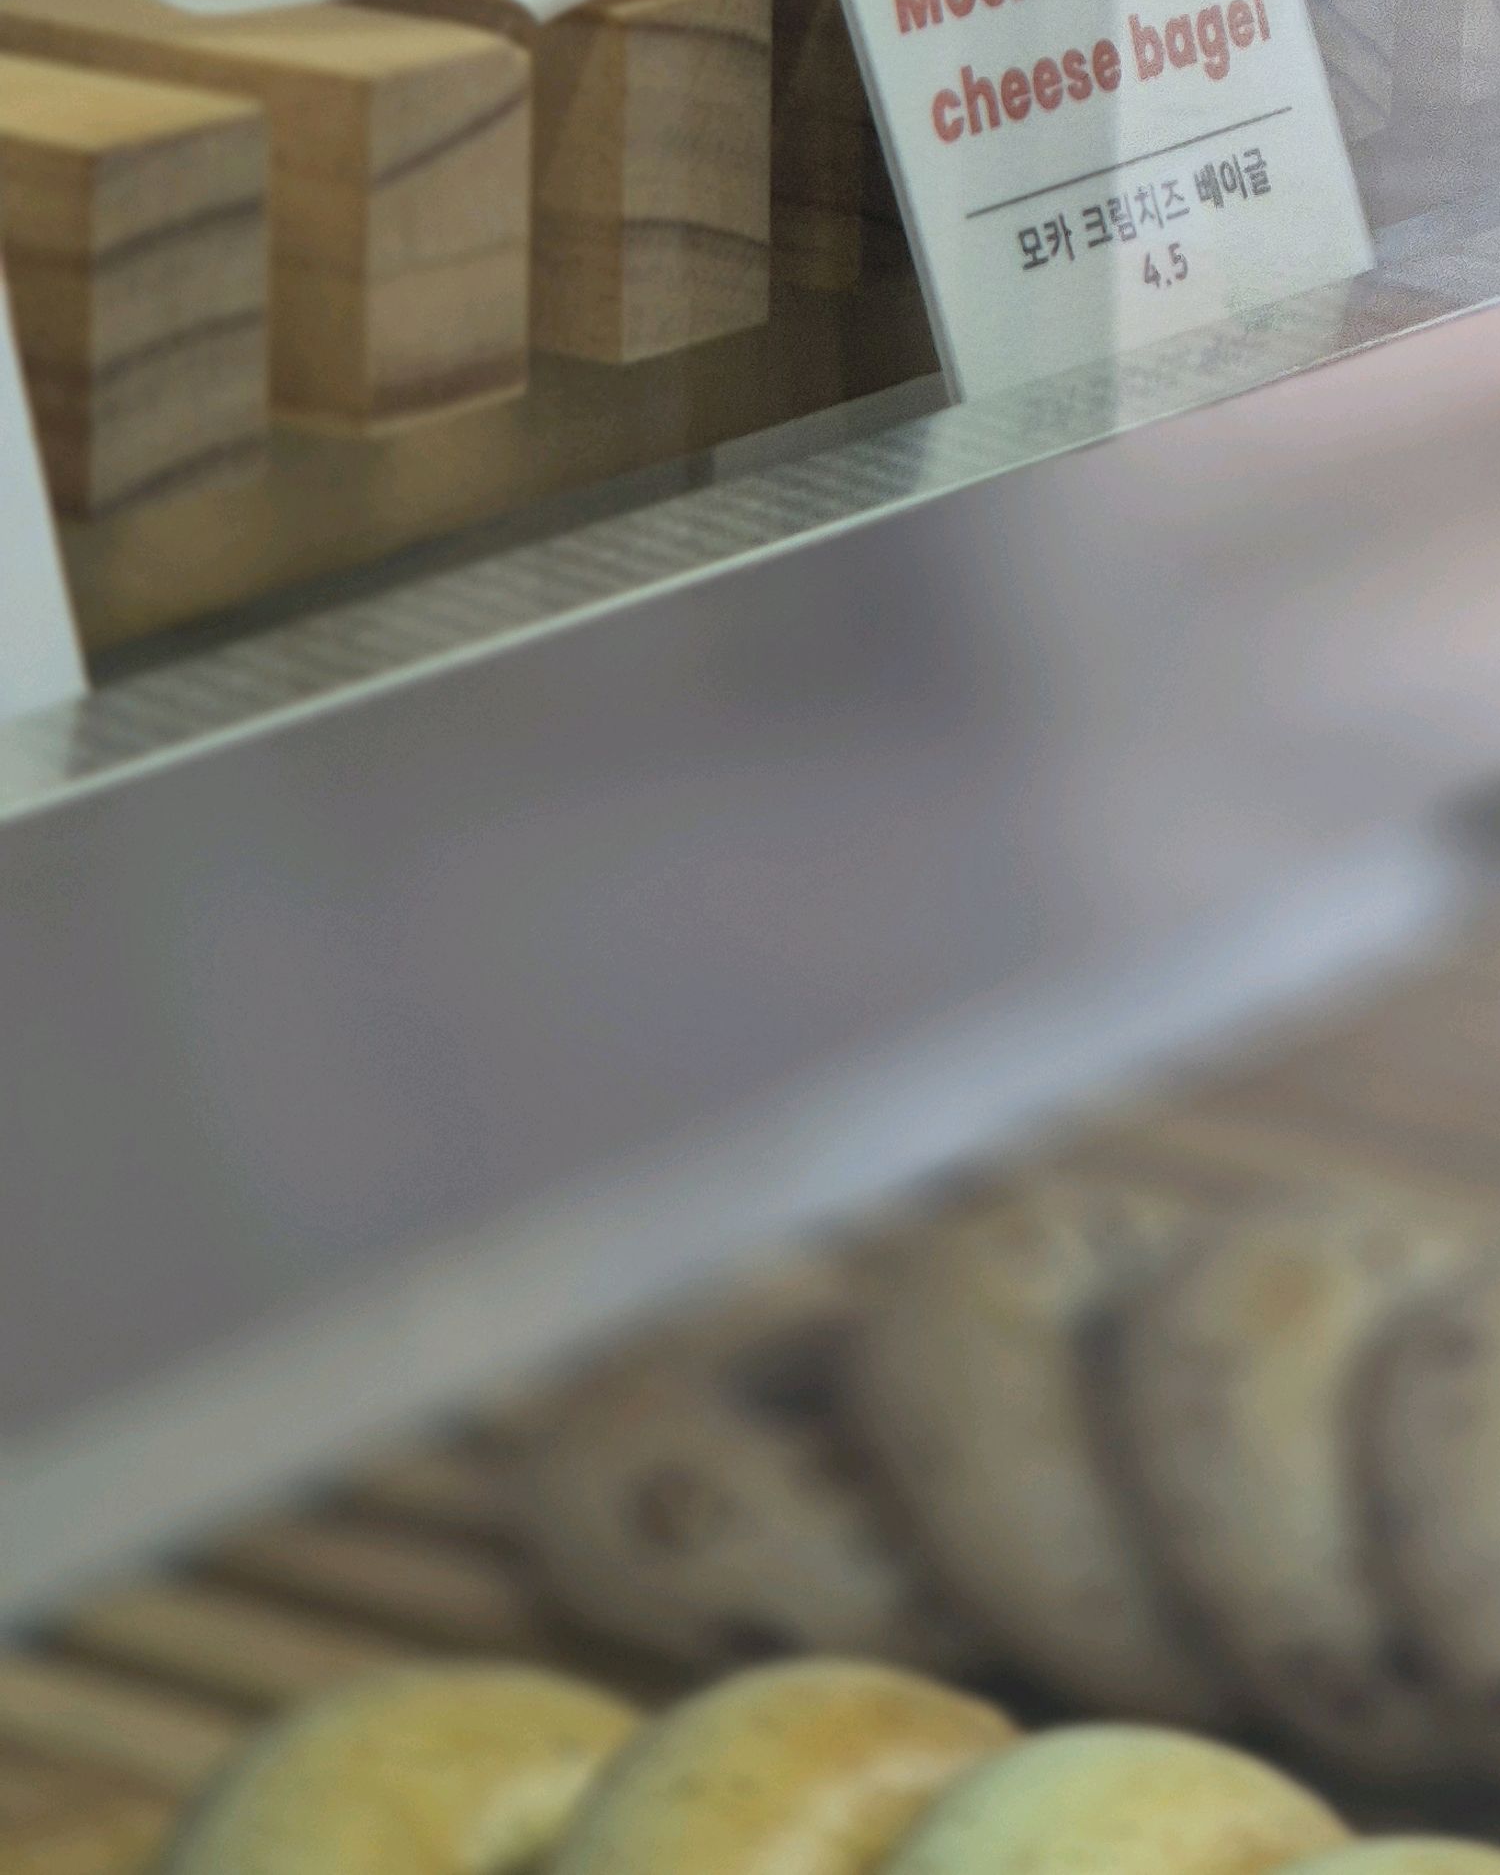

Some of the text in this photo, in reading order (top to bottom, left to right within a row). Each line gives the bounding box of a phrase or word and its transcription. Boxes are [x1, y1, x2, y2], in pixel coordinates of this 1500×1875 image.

[931, 38, 1121, 144] cheese
[1018, 147, 1272, 271] 모카 크림치즈 베이글
[1143, 242, 1189, 288] 4.5
